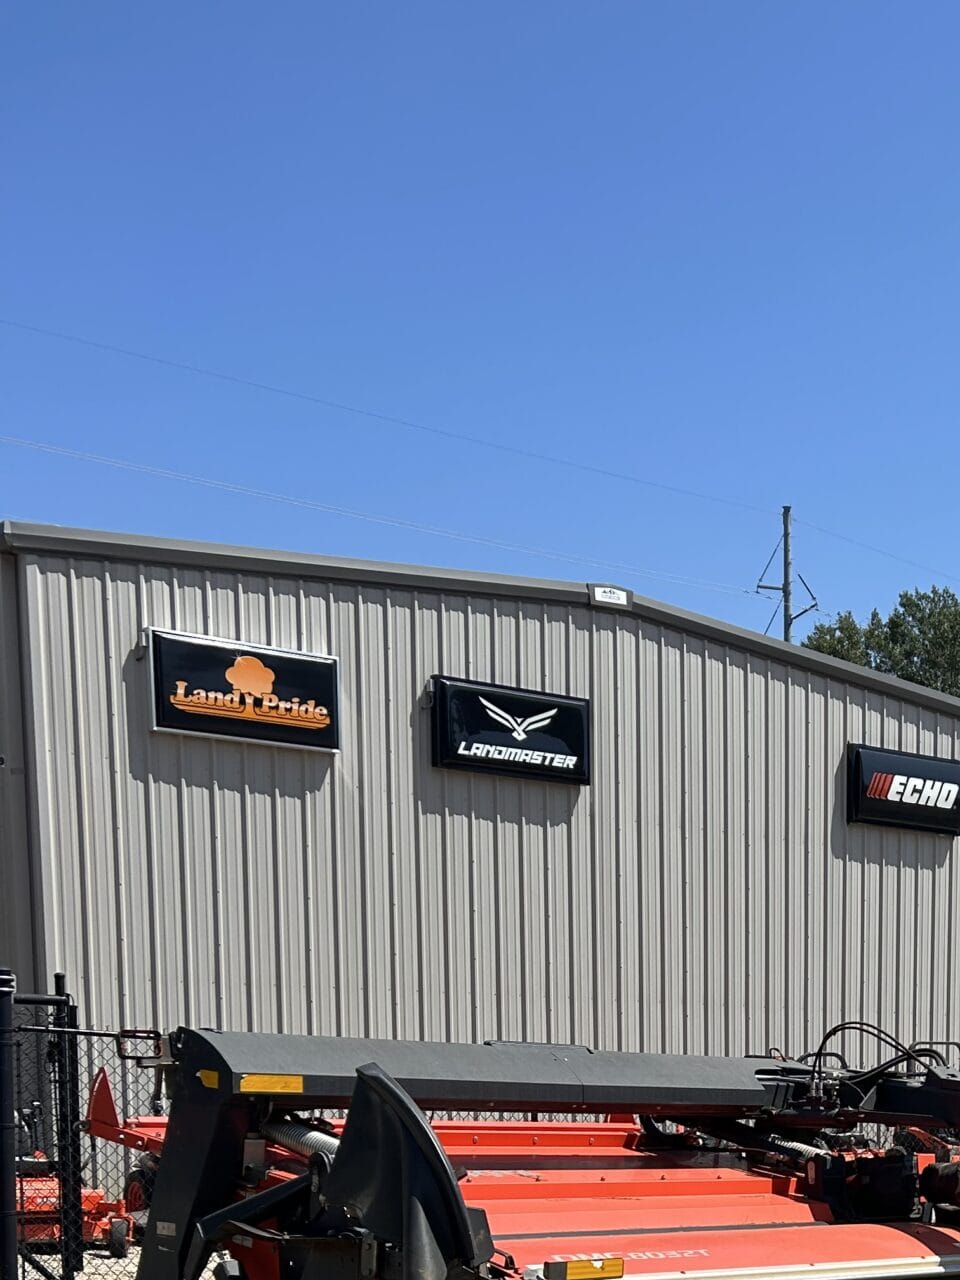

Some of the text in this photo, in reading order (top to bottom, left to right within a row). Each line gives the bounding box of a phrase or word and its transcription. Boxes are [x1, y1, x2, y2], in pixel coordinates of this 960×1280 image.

[174, 681, 329, 720] Land Pride
[457, 741, 577, 768] LANDMASTER
[887, 774, 959, 809] ECHO
